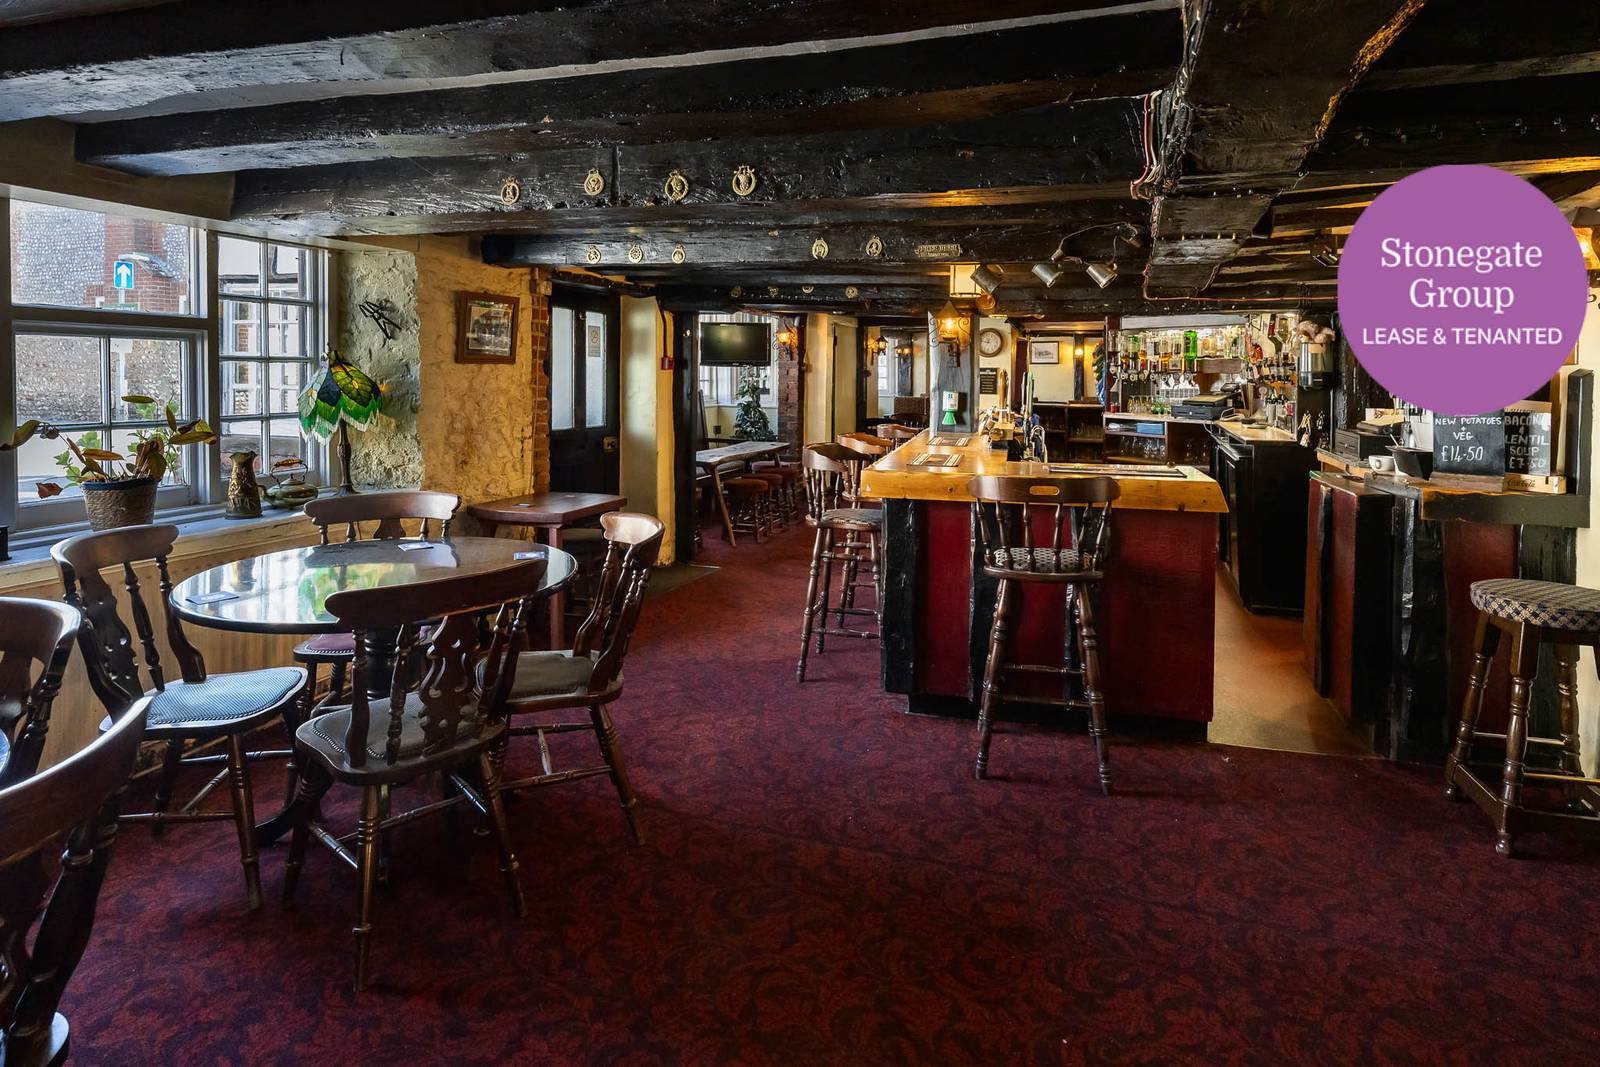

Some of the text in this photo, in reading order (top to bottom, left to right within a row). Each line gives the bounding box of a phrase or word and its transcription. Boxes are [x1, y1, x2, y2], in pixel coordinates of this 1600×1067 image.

[1435, 417, 1502, 426] NEW POTATOES
[1453, 431, 1474, 441] VEG
[1505, 434, 1549, 446] LENTIL
[1510, 446, 1540, 456] SOUP
